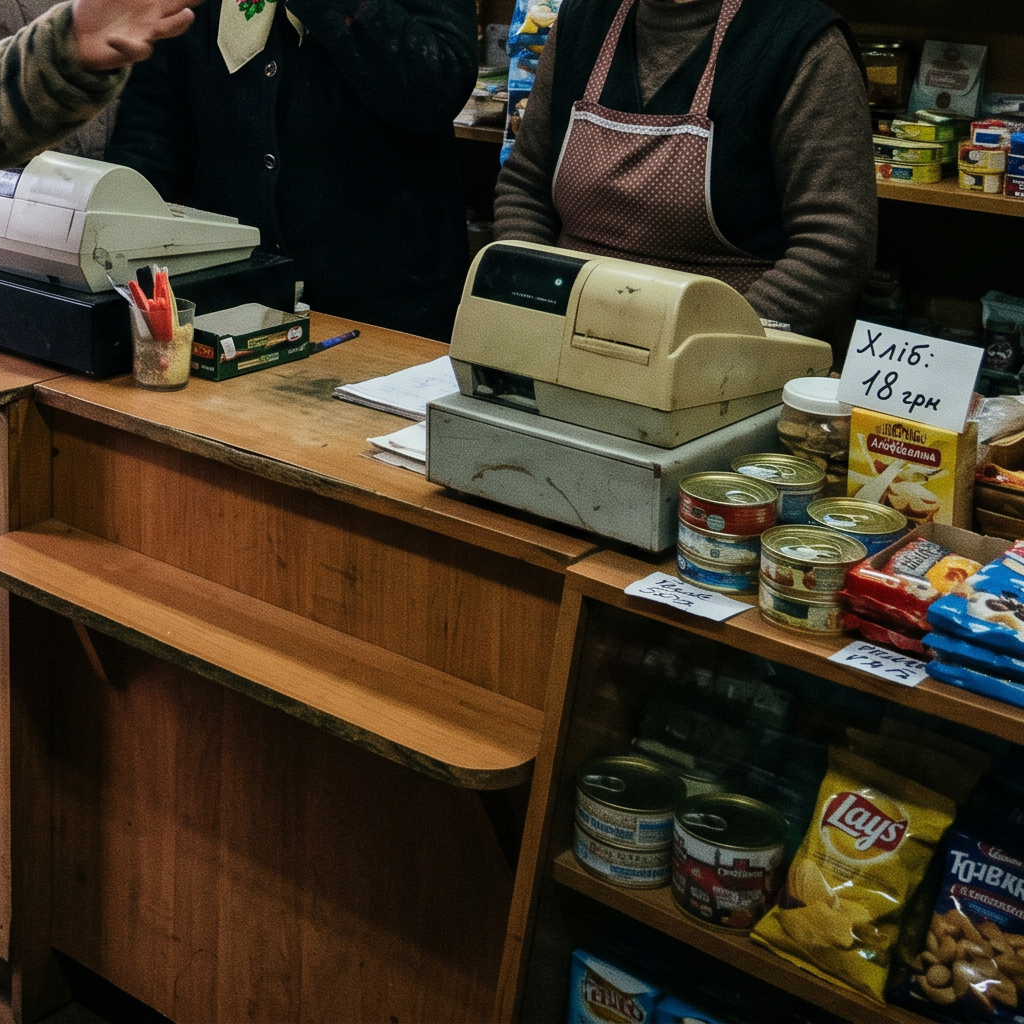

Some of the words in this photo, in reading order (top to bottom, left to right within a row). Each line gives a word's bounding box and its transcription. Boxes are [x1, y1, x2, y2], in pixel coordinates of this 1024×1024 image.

[856, 329, 934, 368] Хліб:
[862, 370, 898, 400] 18
[902, 391, 941, 413] грн
